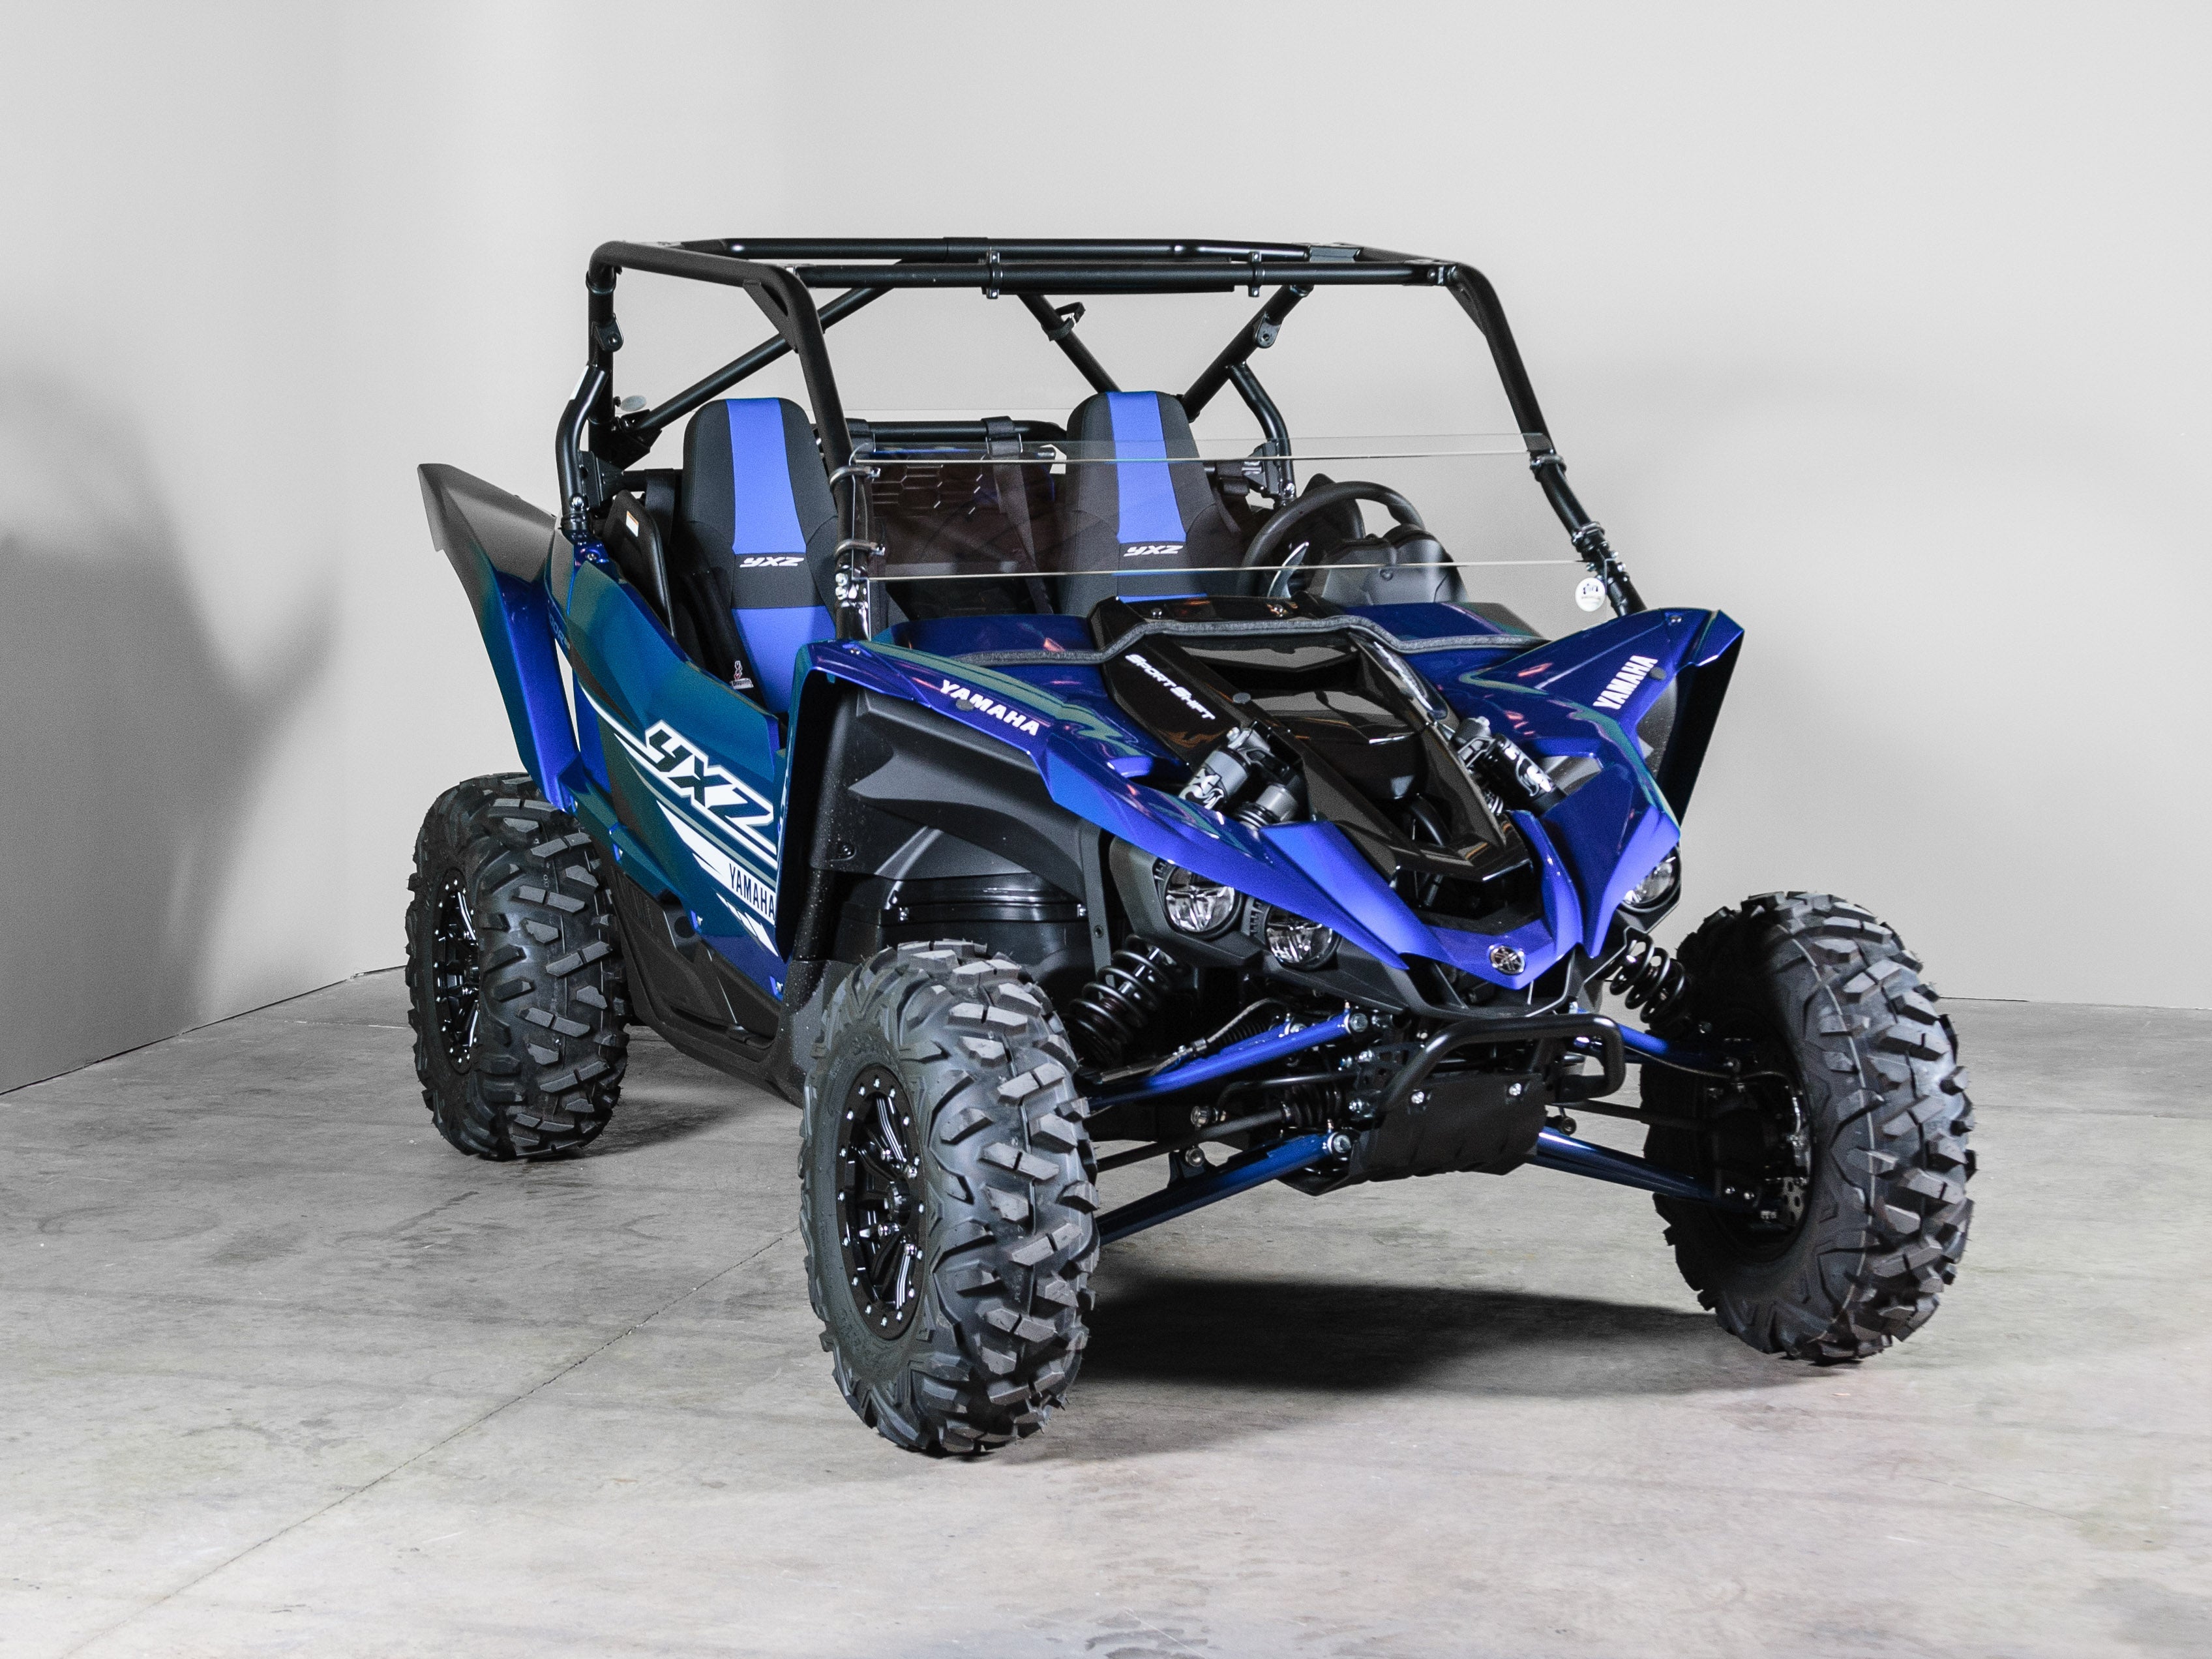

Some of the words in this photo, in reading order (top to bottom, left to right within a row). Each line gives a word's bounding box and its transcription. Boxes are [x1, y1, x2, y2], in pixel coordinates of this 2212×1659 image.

[739, 556, 805, 568] YXZ
[1123, 545, 1184, 557] YXZ
[940, 679, 1039, 736] YAMAHA
[1592, 655, 1658, 710] YAMAHA
[648, 725, 773, 822] YXZ
[729, 863, 775, 921] YAMAHA
